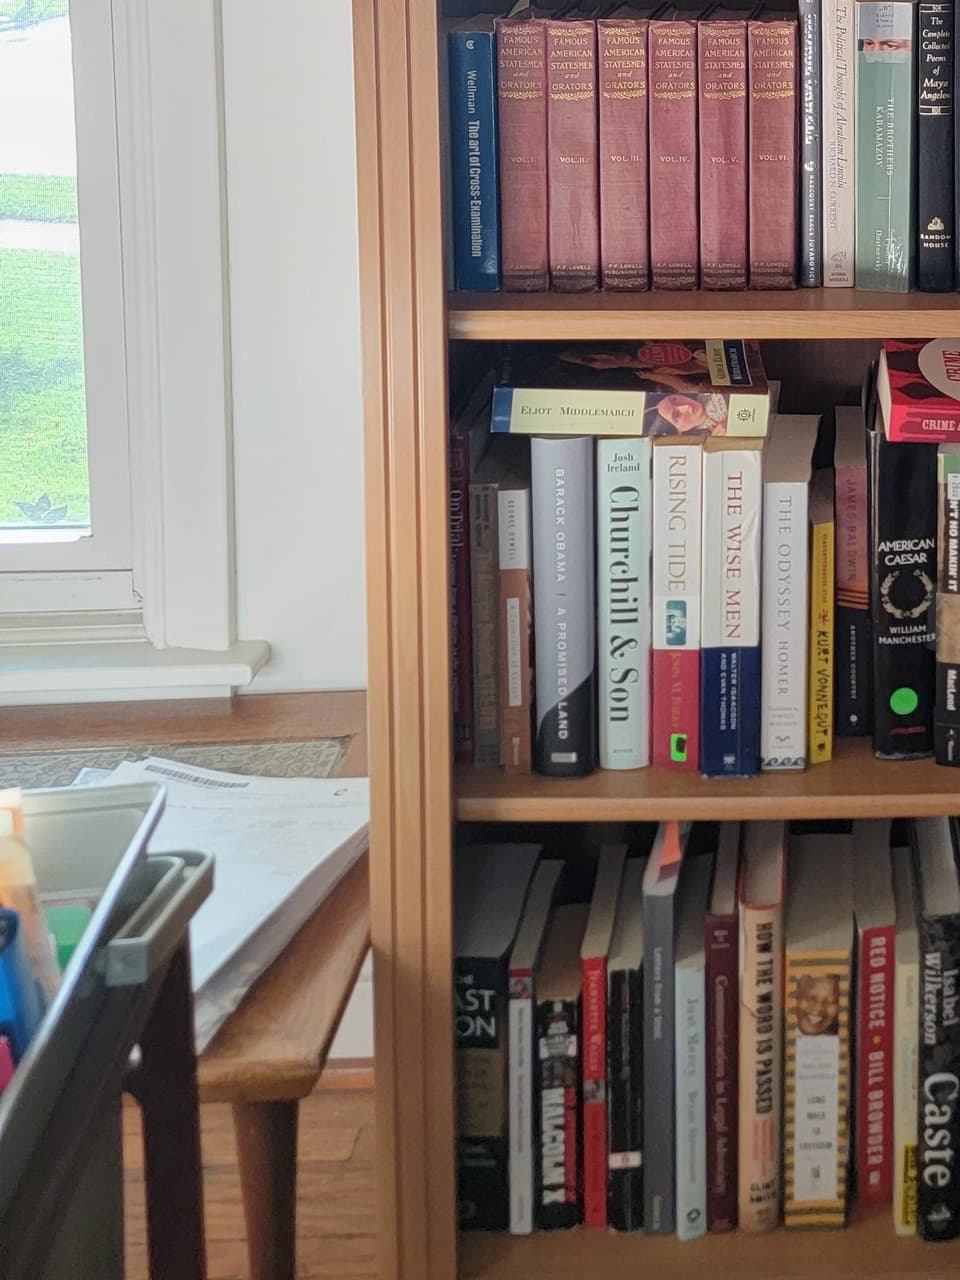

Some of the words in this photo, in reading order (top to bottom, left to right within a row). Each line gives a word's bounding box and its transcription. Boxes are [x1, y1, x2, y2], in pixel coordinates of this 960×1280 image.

[603, 48, 645, 57] AMERICAN
[606, 37, 641, 45] FAMOUS
[603, 60, 646, 69] STATESMEN
[467, 69, 479, 114] Wellman
[605, 81, 646, 89] ORATORS
[467, 119, 482, 139] The
[468, 139, 482, 156] art
[468, 157, 482, 167] of
[468, 167, 483, 258] Cross-Examination
[519, 405, 552, 416] ELIOT
[560, 406, 635, 418] MIDDLEMARCH
[922, 419, 956, 432] CRIME
[555, 467, 567, 526] BARACK
[667, 454, 688, 531] RISING
[726, 471, 743, 516] THE
[778, 496, 793, 535] THE
[555, 531, 567, 583] OBAMA
[608, 485, 641, 626] Churchill
[725, 523, 742, 580] WISE
[877, 537, 935, 553] AMERICAN
[884, 552, 928, 566] CAESAR
[667, 538, 687, 593] TIDE
[776, 543, 793, 632] ODYSSEY
[556, 606, 567, 618] A
[725, 587, 742, 640] MEN
[889, 624, 927, 634] WILLIAM
[608, 634, 640, 660] &
[878, 633, 936, 645] MANCHESTER
[556, 622, 567, 698] PROMISED
[777, 640, 791, 696] HOMER
[608, 666, 640, 723] Son
[556, 700, 568, 740] LAND
[756, 921, 774, 954] HOW
[869, 935, 887, 968] RED
[756, 959, 774, 986] THE
[756, 993, 774, 1035] WORD
[867, 973, 886, 1031] NOTICE
[922, 951, 942, 1047] Wilkerson
[942, 967, 960, 1028] Isabel
[756, 1038, 774, 1055] IS
[755, 1058, 774, 1115] PASSED
[867, 1050, 885, 1086] BILL
[542, 1087, 567, 1186] MALCOLM
[866, 1090, 884, 1166] BROWDER
[924, 1071, 960, 1189] Caste
[543, 1188, 566, 1206] X
